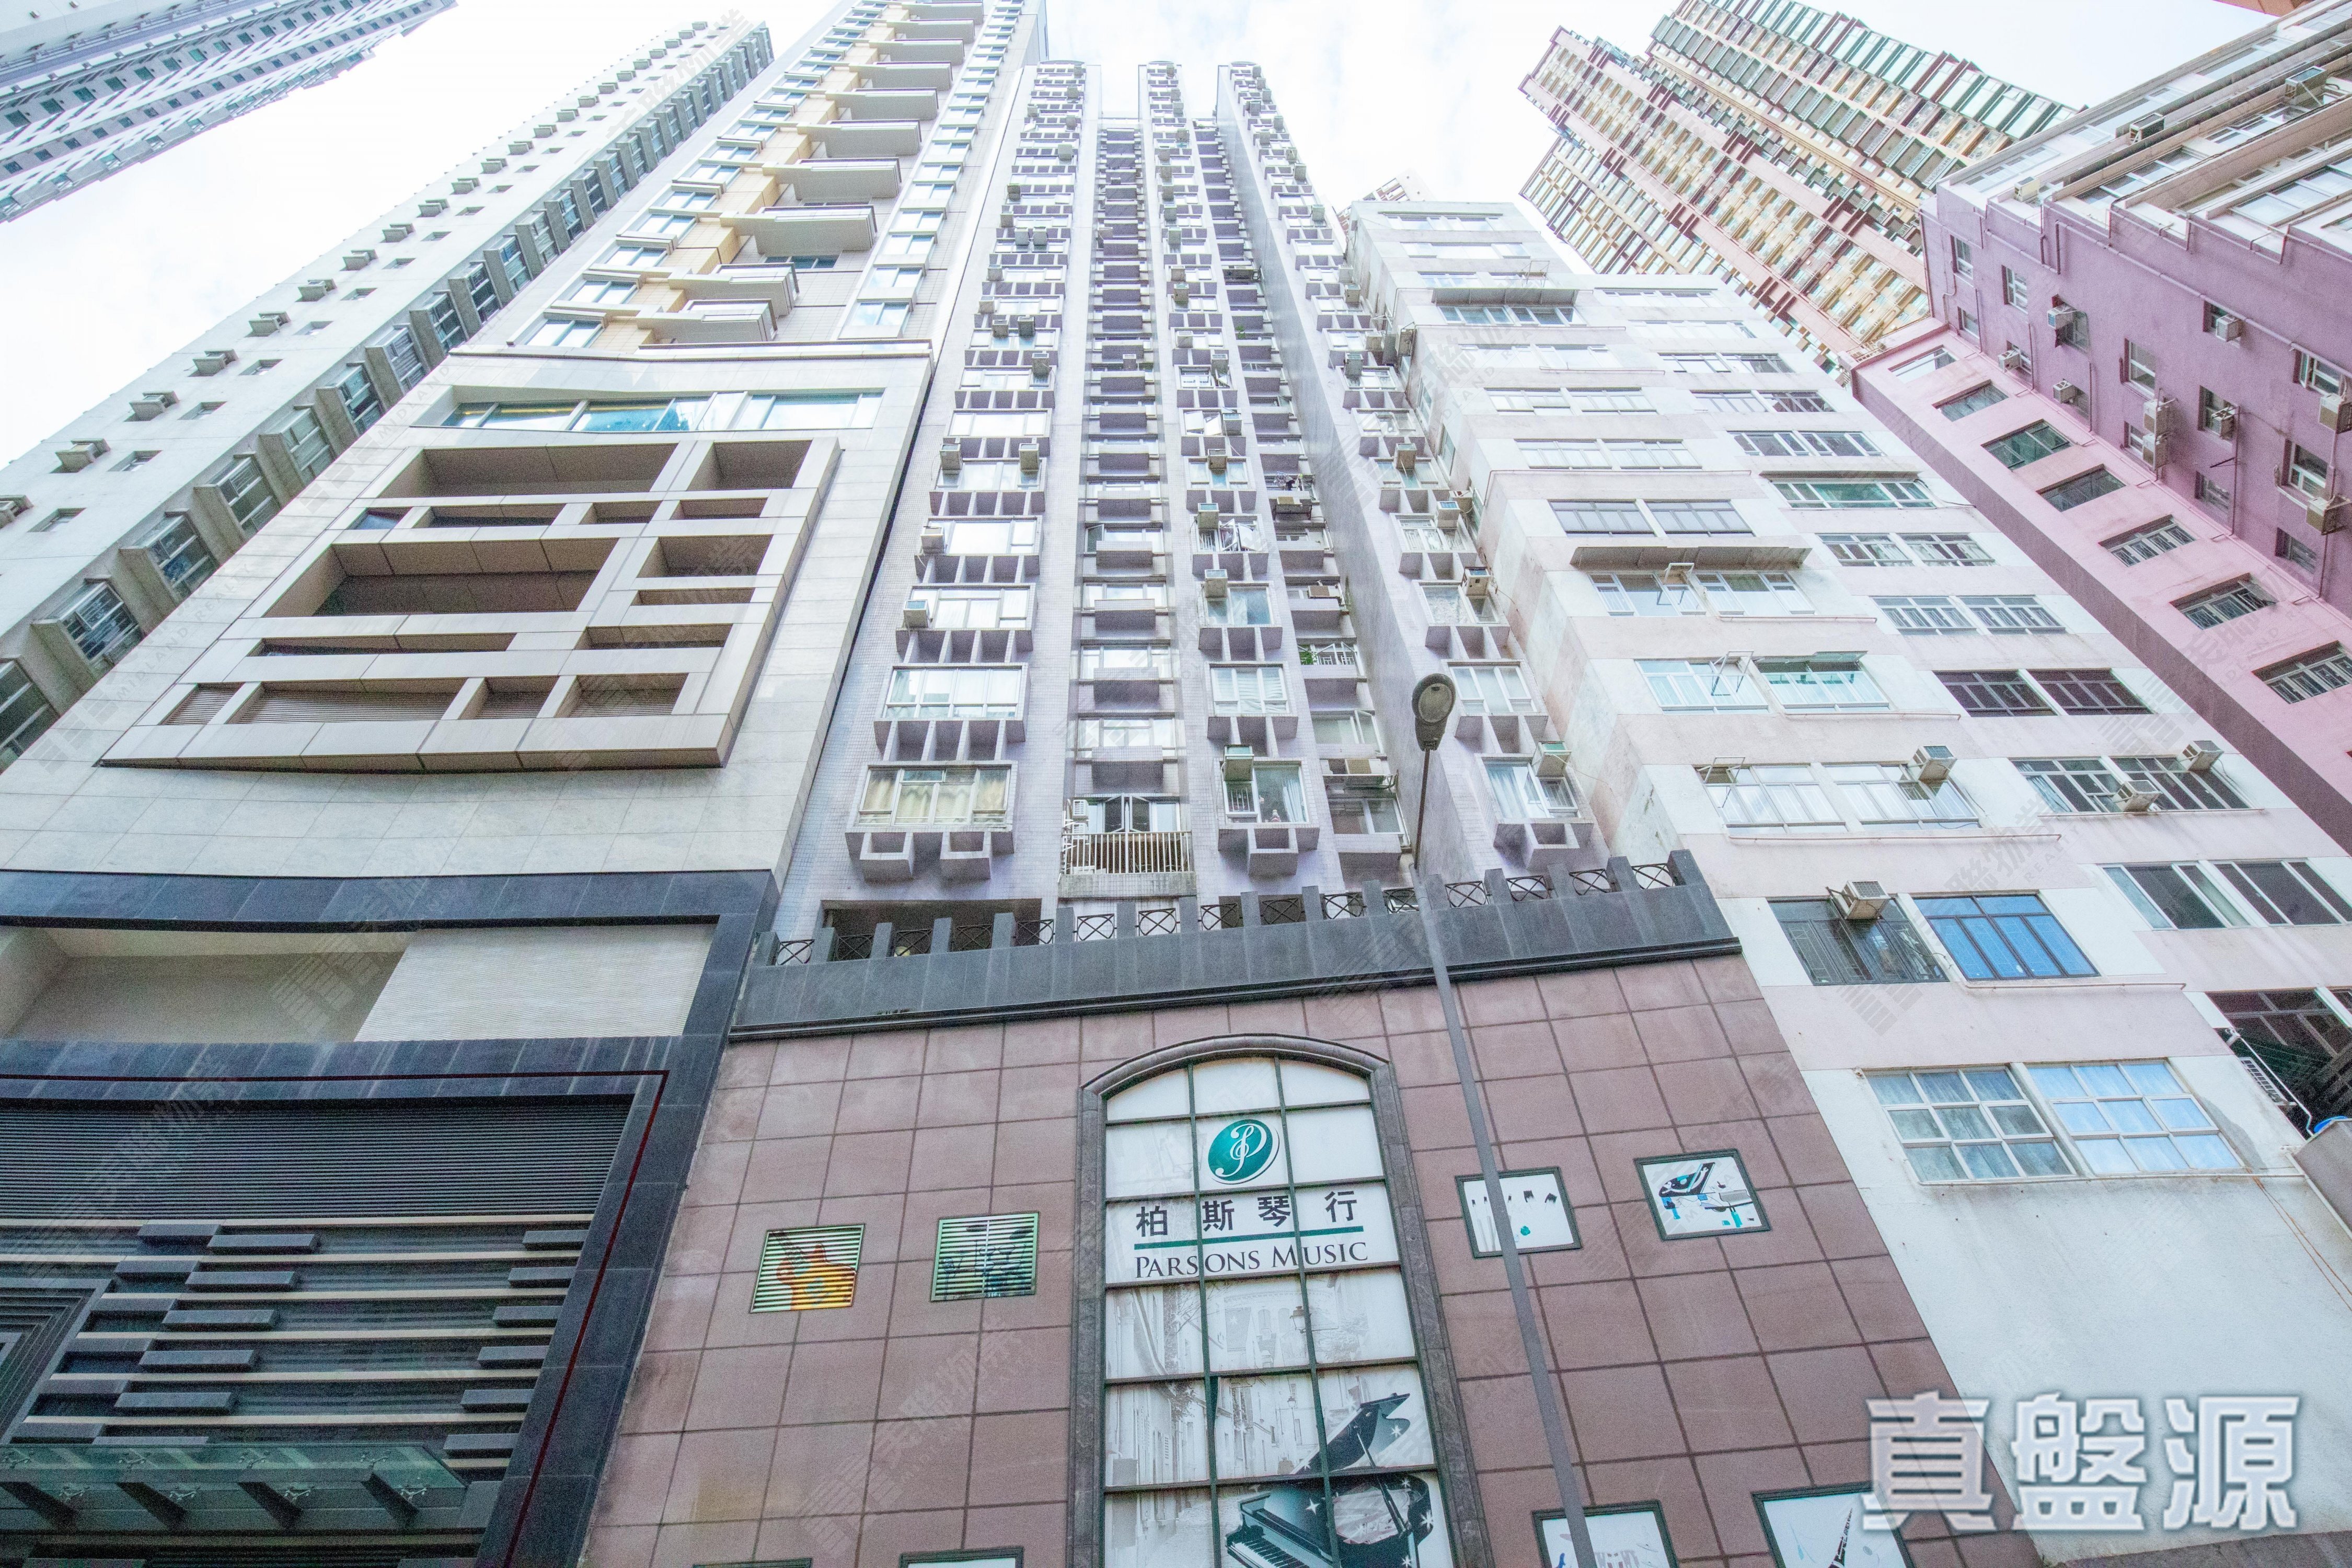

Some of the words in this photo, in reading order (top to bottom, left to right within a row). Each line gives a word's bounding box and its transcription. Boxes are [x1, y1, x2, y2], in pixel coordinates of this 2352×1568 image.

[1136, 1190, 1357, 1237] 柏斯琴行
[1135, 1250, 1261, 1279] PARSONS
[1272, 1241, 1368, 1269] MUSIC
